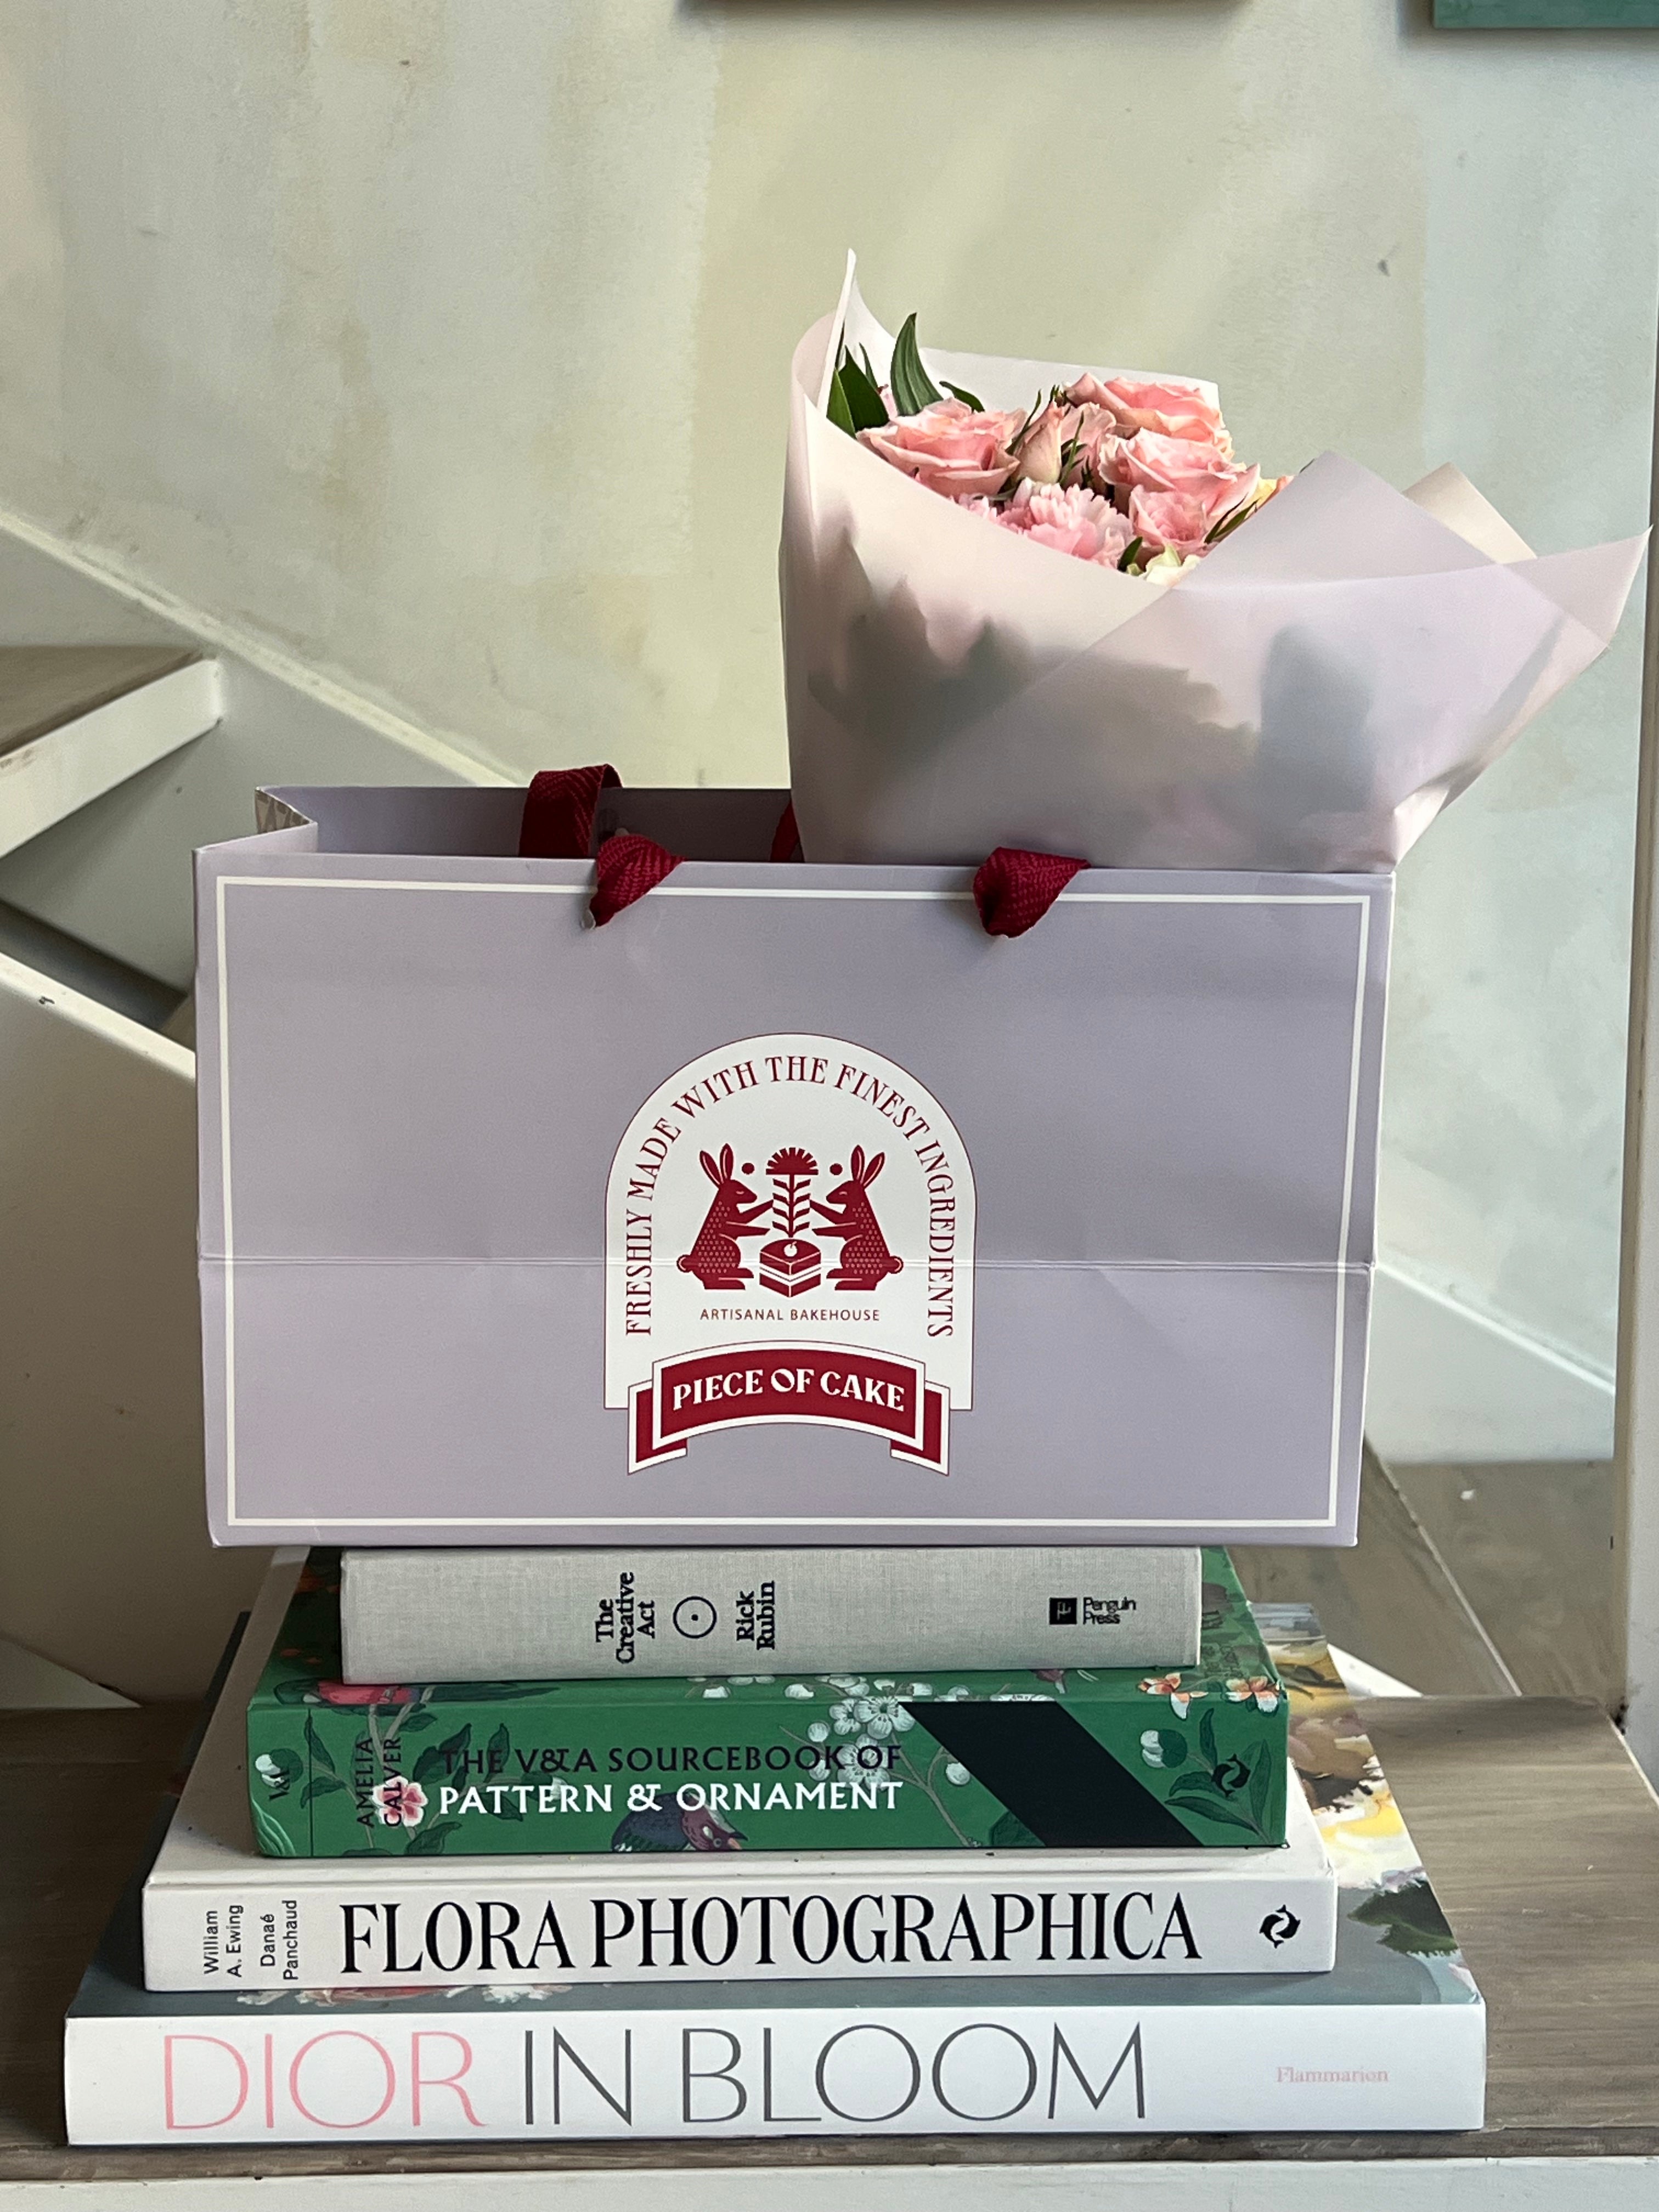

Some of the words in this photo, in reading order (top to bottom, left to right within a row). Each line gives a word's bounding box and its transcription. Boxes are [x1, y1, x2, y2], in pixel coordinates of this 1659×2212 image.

[671, 1062, 759, 1120] WITH
[765, 1055, 829, 1084] THE
[834, 1063, 930, 1142] FINEST
[627, 1118, 681, 1201] MADE
[915, 1140, 955, 1338] INGREDIENTS
[625, 1209, 652, 1335] FRESHLY
[700, 1309, 783, 1321] ARTISANAL
[790, 1309, 880, 1321] BAKEHOUSE
[673, 1369, 763, 1412] PIECE
[770, 1368, 814, 1393] OF
[821, 1370, 904, 1412] CAKE
[595, 1599, 614, 1642] The
[616, 1572, 635, 1663] Creative
[637, 1600, 655, 1639] Act
[736, 1590, 754, 1641] Rick
[756, 1580, 775, 1650] Rubin
[1083, 1596, 1136, 1612] Penguin
[1083, 1611, 1120, 1624] Press
[357, 1737, 374, 1827] AMELIA
[383, 1736, 402, 1827] CALVER
[443, 1750, 503, 1774] THE
[514, 1748, 597, 1773] V&A
[608, 1746, 843, 1772] SOURCEBOOK
[857, 1746, 902, 1769] OF
[439, 1785, 613, 1814] PATTERN
[627, 1784, 662, 1812] &
[676, 1782, 903, 1811] ORNAMENT
[204, 1910, 219, 1974] William
[225, 1905, 244, 1954] Ewing
[260, 1914, 275, 1967] Danaé
[282, 1900, 298, 1980] Panchaud
[339, 1900, 575, 1973] FLORA
[590, 1892, 1203, 1967] PHOTOGRAPHICA
[227, 1959, 242, 1978] A.
[163, 2030, 489, 2130] DIOR
[524, 2027, 632, 2127] IN
[682, 2021, 1146, 2123] BLOOM
[1277, 2066, 1389, 2083] Flammarion
